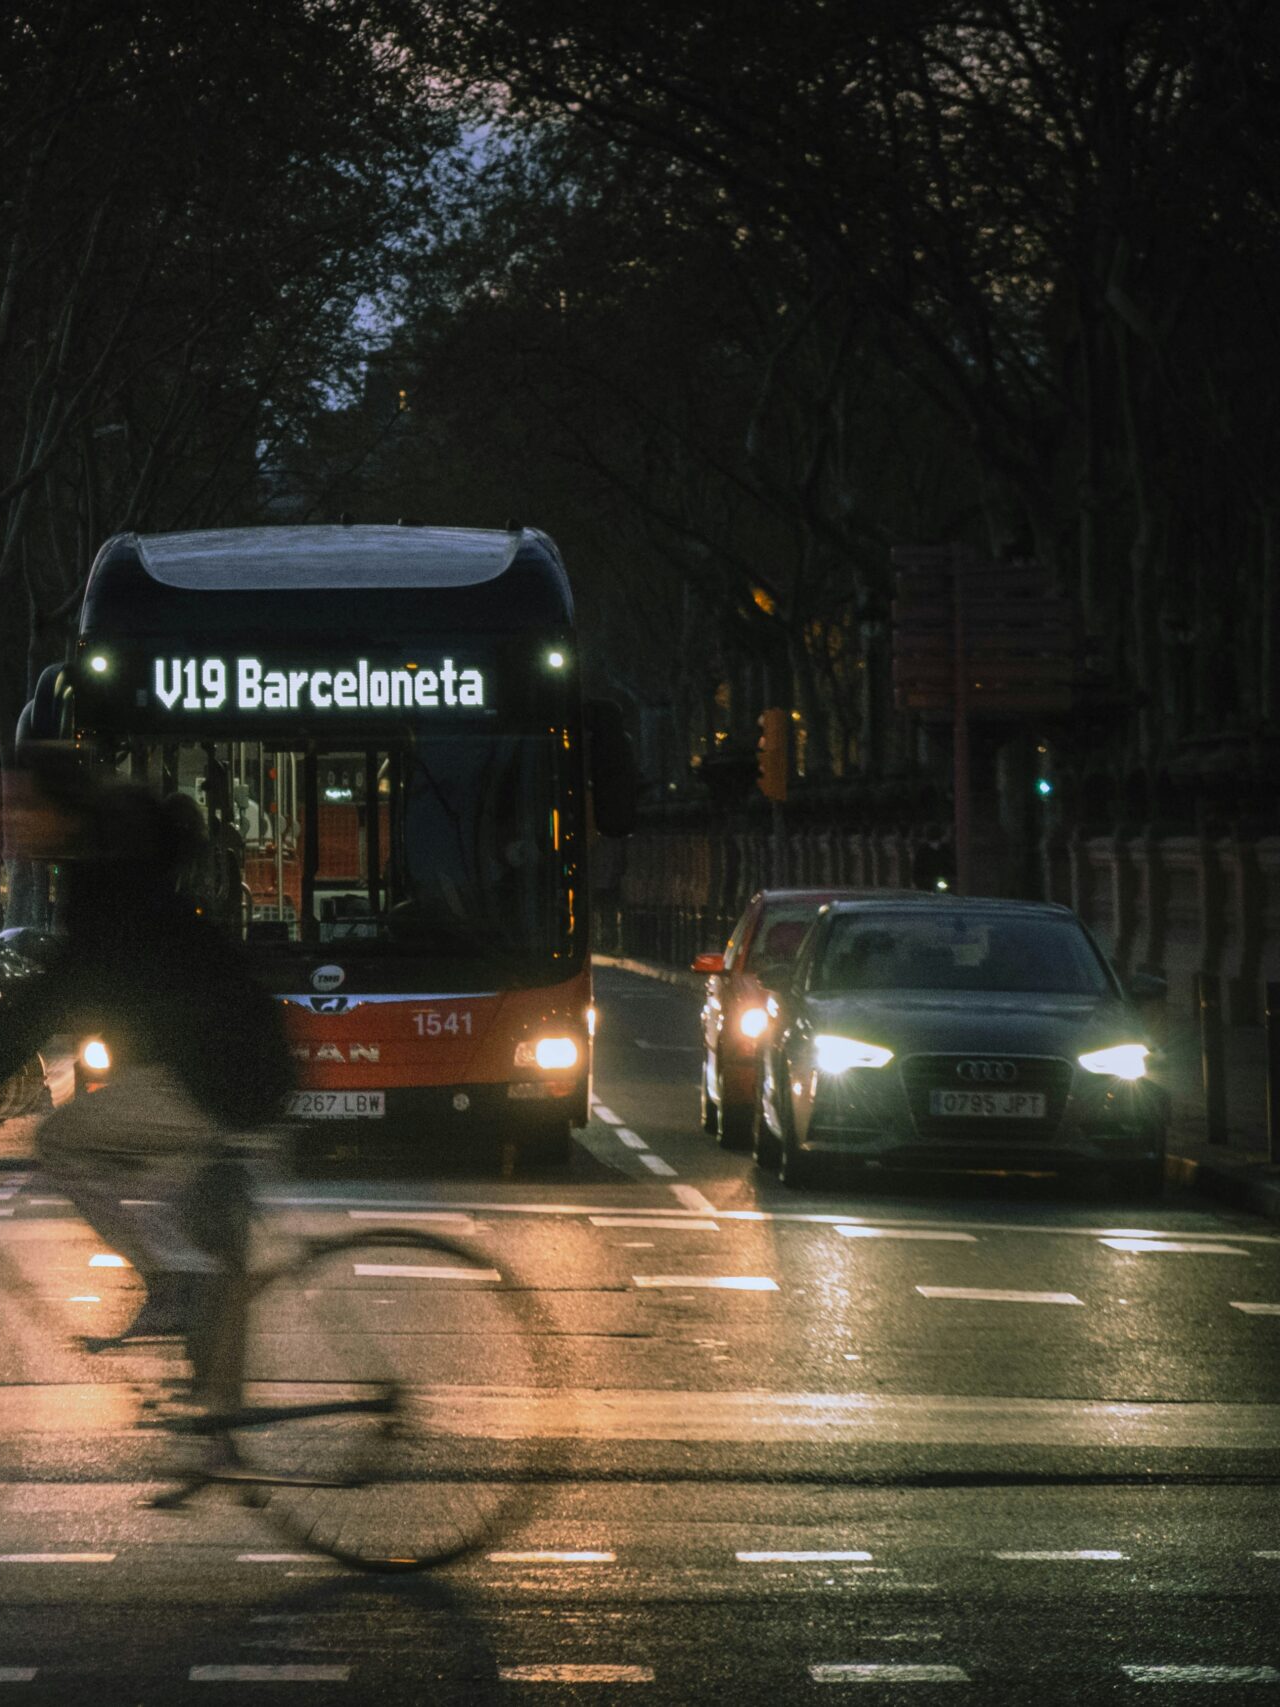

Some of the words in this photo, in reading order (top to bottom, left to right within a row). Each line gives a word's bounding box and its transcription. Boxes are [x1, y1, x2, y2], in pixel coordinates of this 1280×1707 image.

[155, 659, 226, 709] V19
[237, 658, 484, 708] Barceloneta
[412, 1011, 473, 1036] 1541
[289, 1094, 337, 1113] 7267
[343, 1095, 381, 1113] LBW
[943, 1093, 997, 1114] 0795
[1002, 1095, 1041, 1114] JPT
